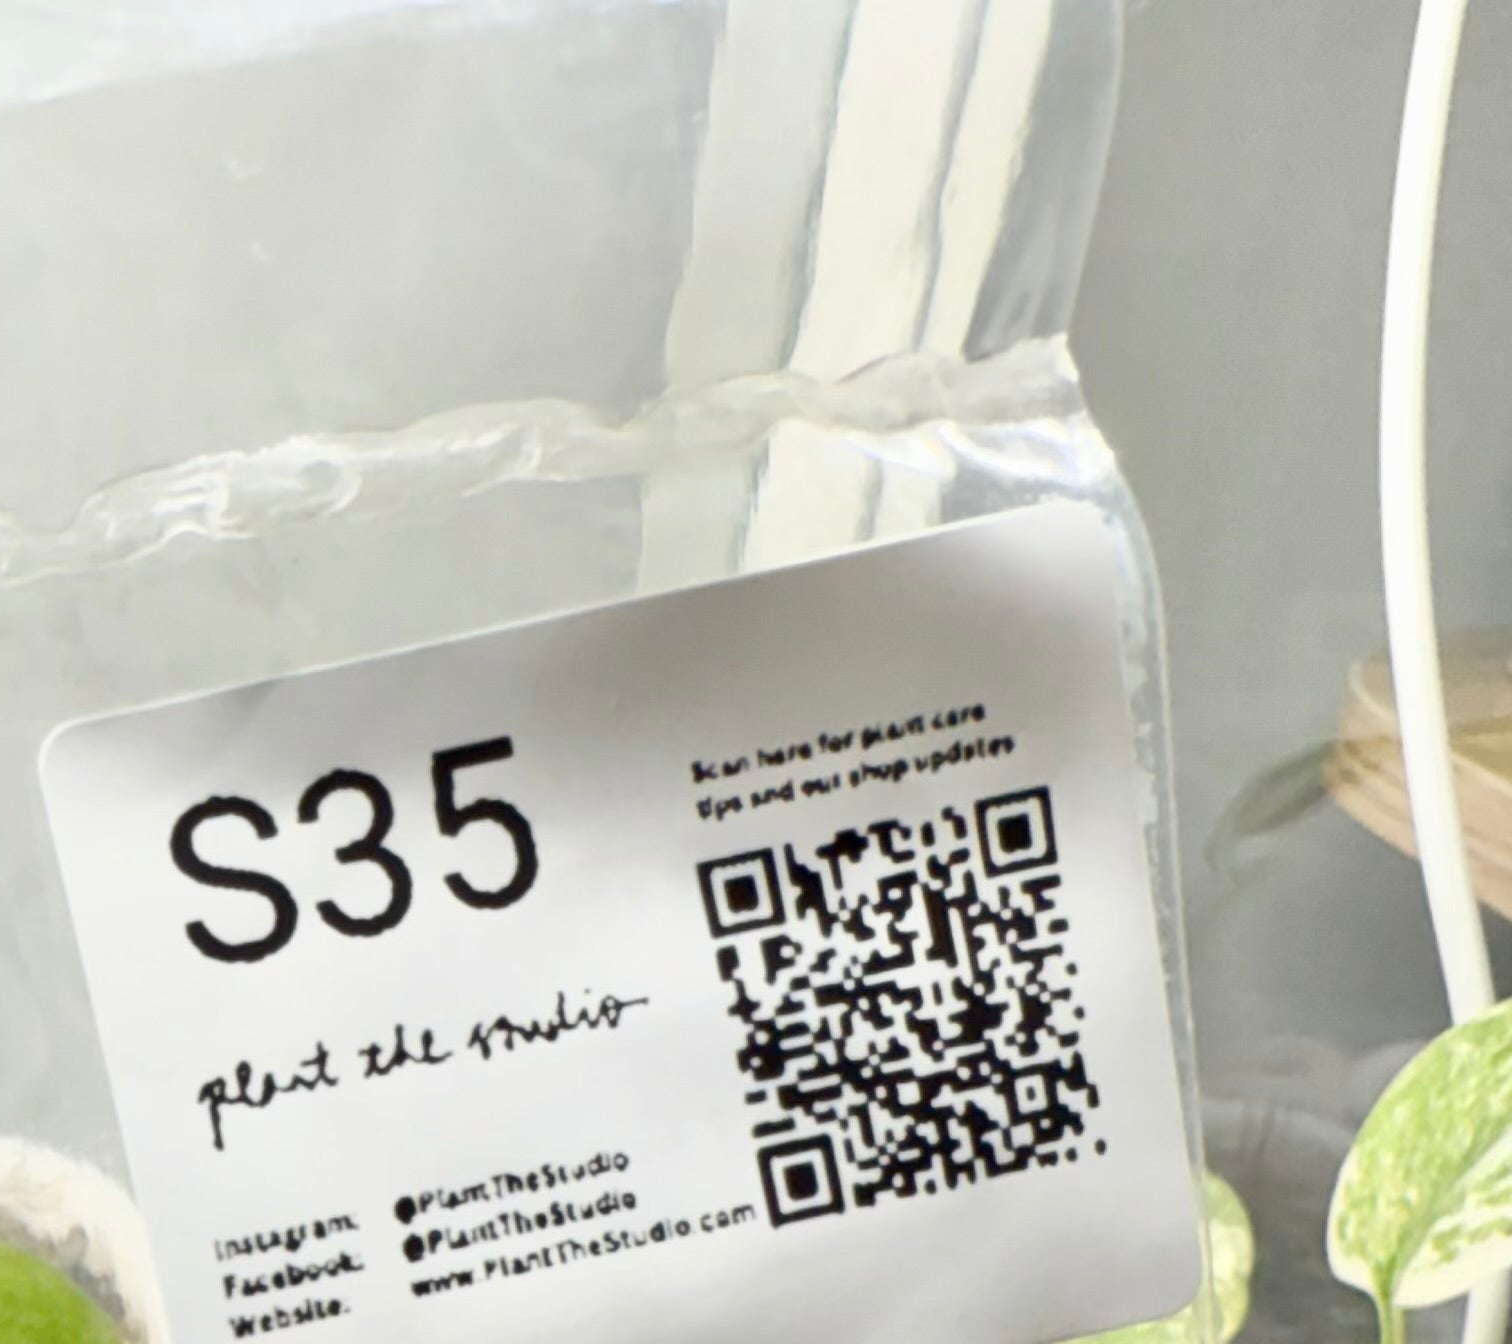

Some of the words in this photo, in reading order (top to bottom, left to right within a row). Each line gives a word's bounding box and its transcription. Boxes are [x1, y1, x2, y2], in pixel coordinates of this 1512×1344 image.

[691, 757, 749, 783] Scan
[757, 743, 812, 768] here
[819, 731, 853, 753] for
[861, 715, 924, 750] plant
[932, 704, 986, 730] care
[751, 780, 794, 808] and
[801, 774, 840, 796] our
[849, 758, 908, 787] shop
[915, 735, 1015, 772] updates
[170, 736, 538, 963] S35
[198, 1041, 338, 1151] plant
[358, 1024, 453, 1079] the
[467, 988, 649, 1060] studio
[411, 1203, 757, 1297] www.PlantTheStudio.com
